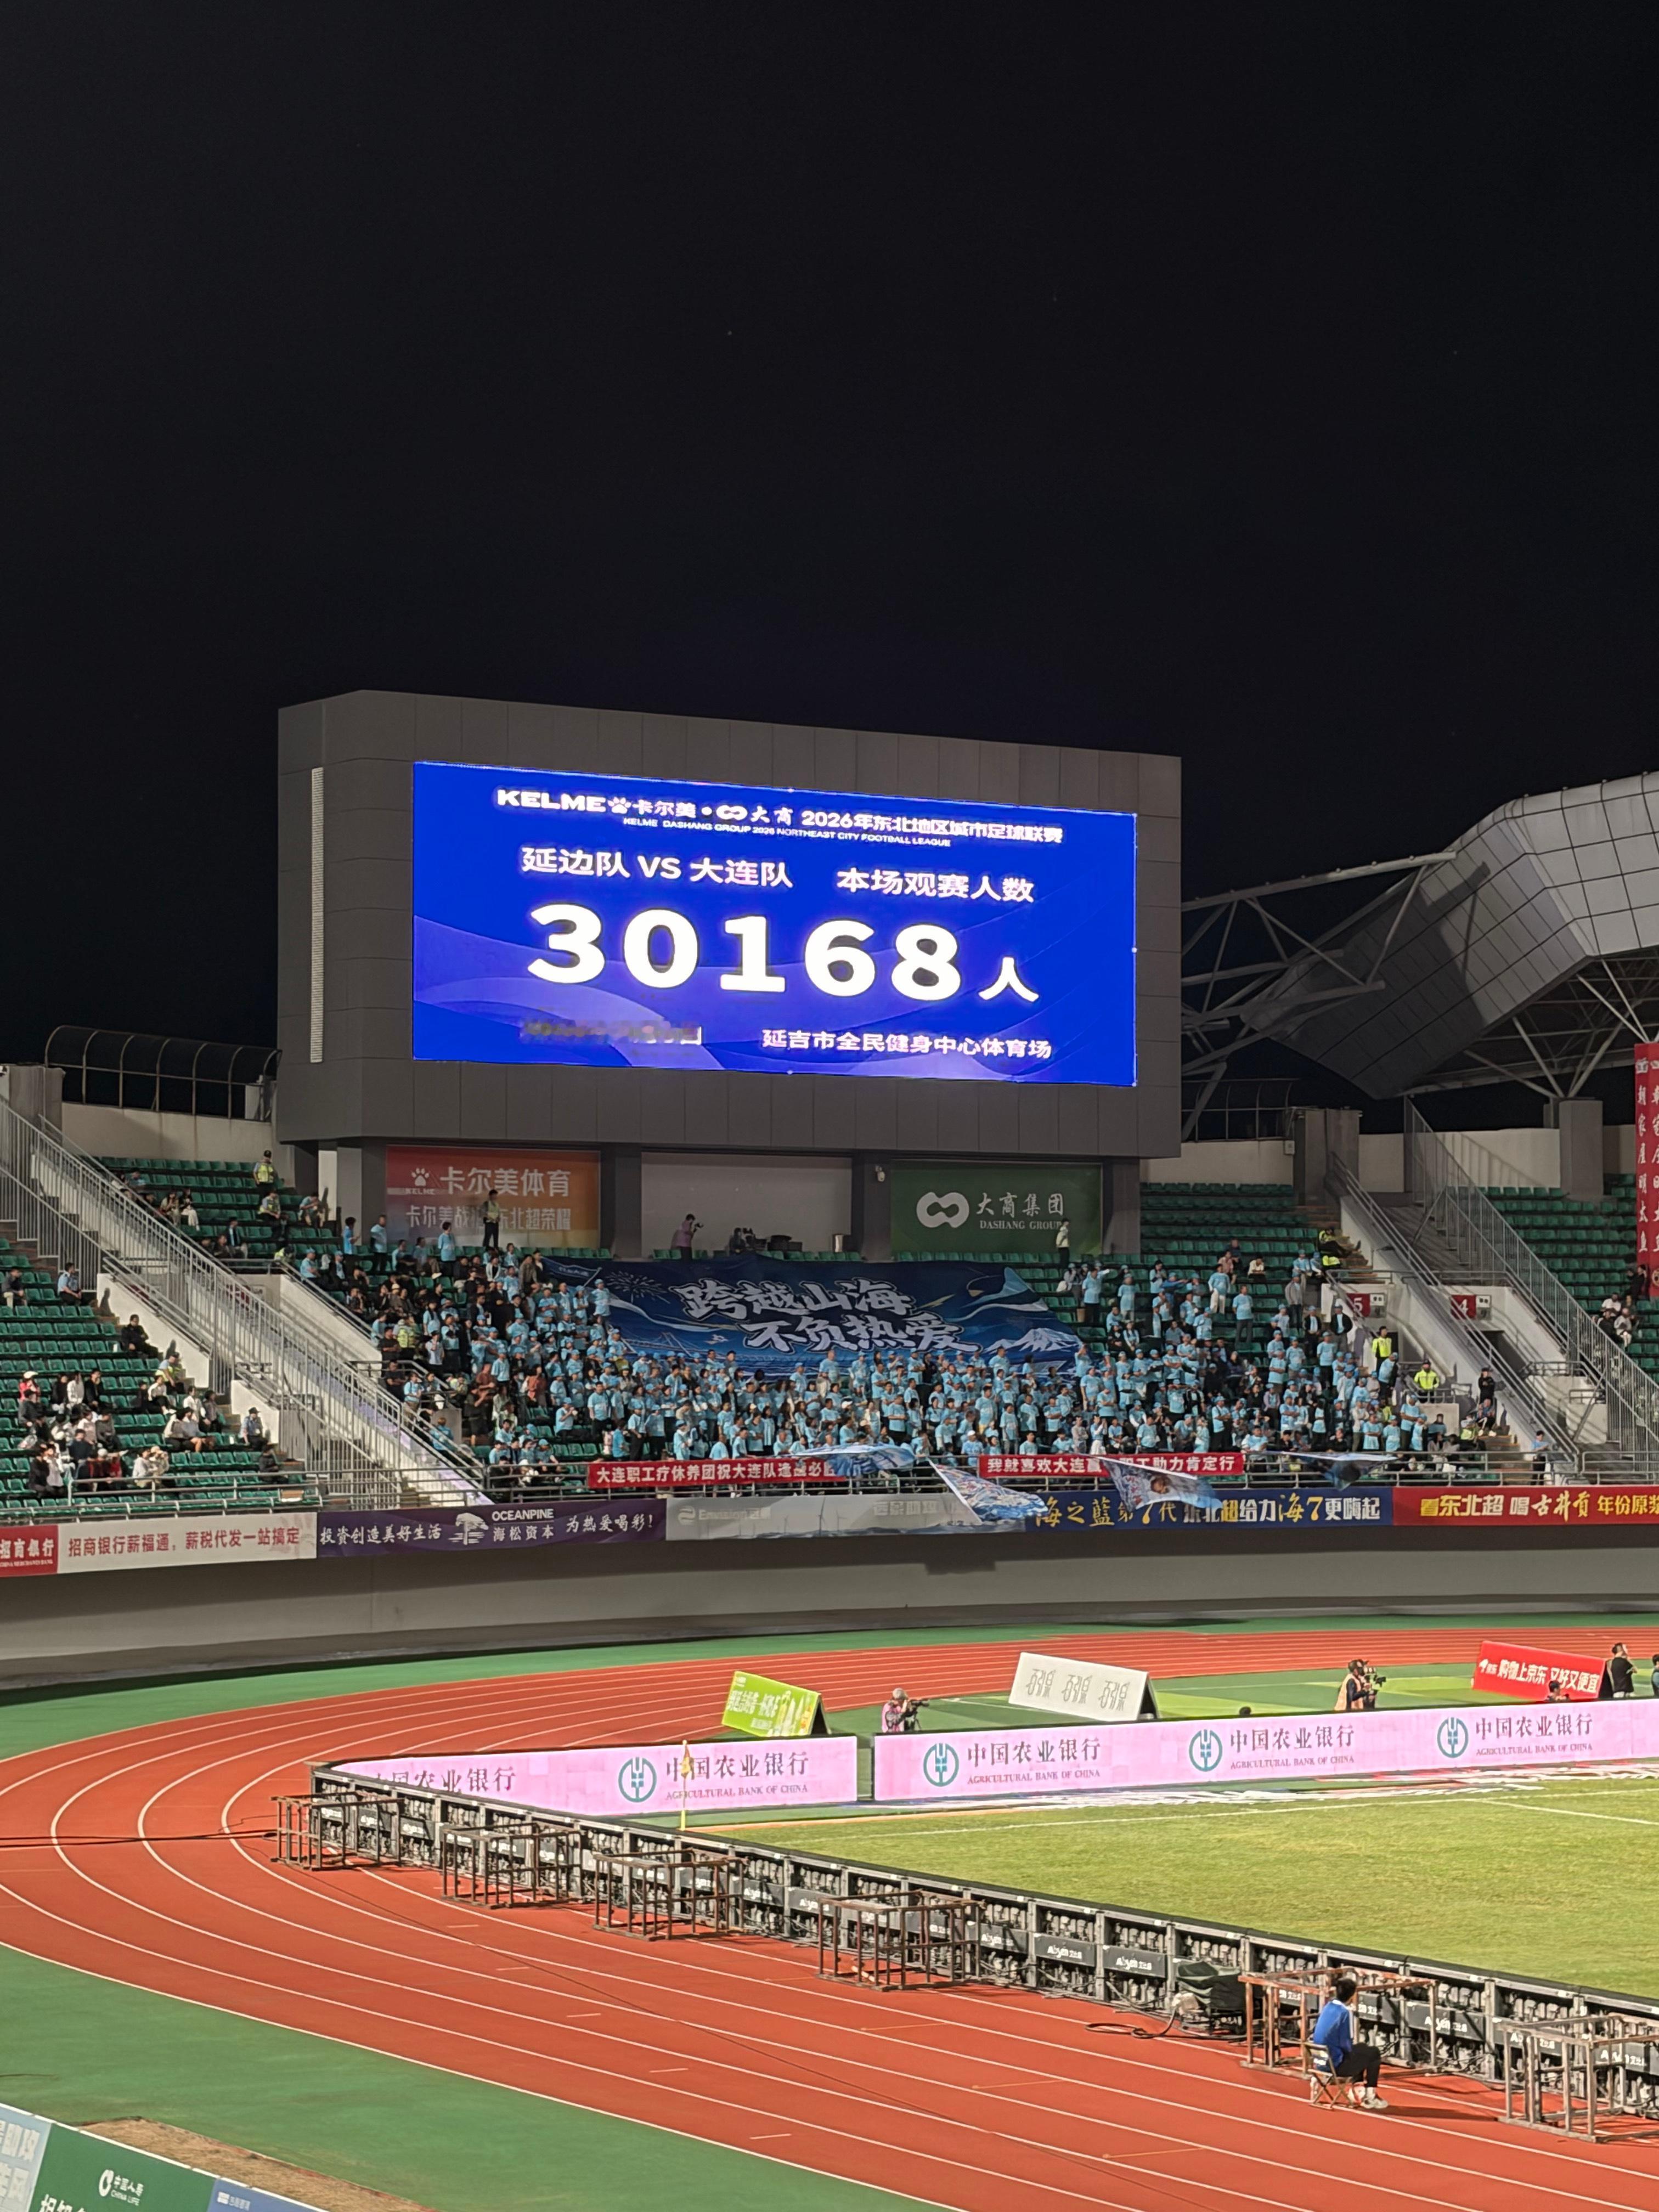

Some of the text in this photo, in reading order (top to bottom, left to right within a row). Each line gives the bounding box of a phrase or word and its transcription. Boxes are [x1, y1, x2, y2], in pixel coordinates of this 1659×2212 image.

[497, 789, 606, 812] KELME
[623, 817, 658, 827] KELME
[663, 820, 713, 831] DASHANG
[714, 823, 751, 833] GROUP
[776, 827, 836, 839] NORTHEAST
[861, 833, 911, 844] FOOTBALL
[912, 837, 951, 847] LEAGUE
[521, 847, 1035, 903] 延边队 VS 大连队 本场观赛人数
[527, 904, 1040, 1003] 30168 人
[762, 1028, 1052, 1059] 延吉市全民健身中心体育场
[440, 1166, 571, 1198] 卡尔美体育
[976, 1192, 1064, 1218] 大商集团
[980, 1220, 1025, 1230] DASHANG
[674, 1282, 913, 1318] 跨越山海
[741, 1314, 981, 1353] 不负热爱
[492, 1509, 554, 1521] OCEANPINE
[320, 1523, 442, 1545] 投资创造美好生活
[1230, 1724, 1355, 1753] 中国农业银行
[1475, 1713, 1593, 1741] 中国农业银行
[967, 1737, 1101, 1768] 中国农业银行
[1230, 1758, 1291, 1770] AGRICULTURAL
[1294, 1757, 1316, 1767] BANK
[1330, 1754, 1355, 1764] CHINA
[738, 1786, 763, 1796] BANK
[967, 1769, 1101, 1785] AGRICULTURAL BANK OF CHINA
